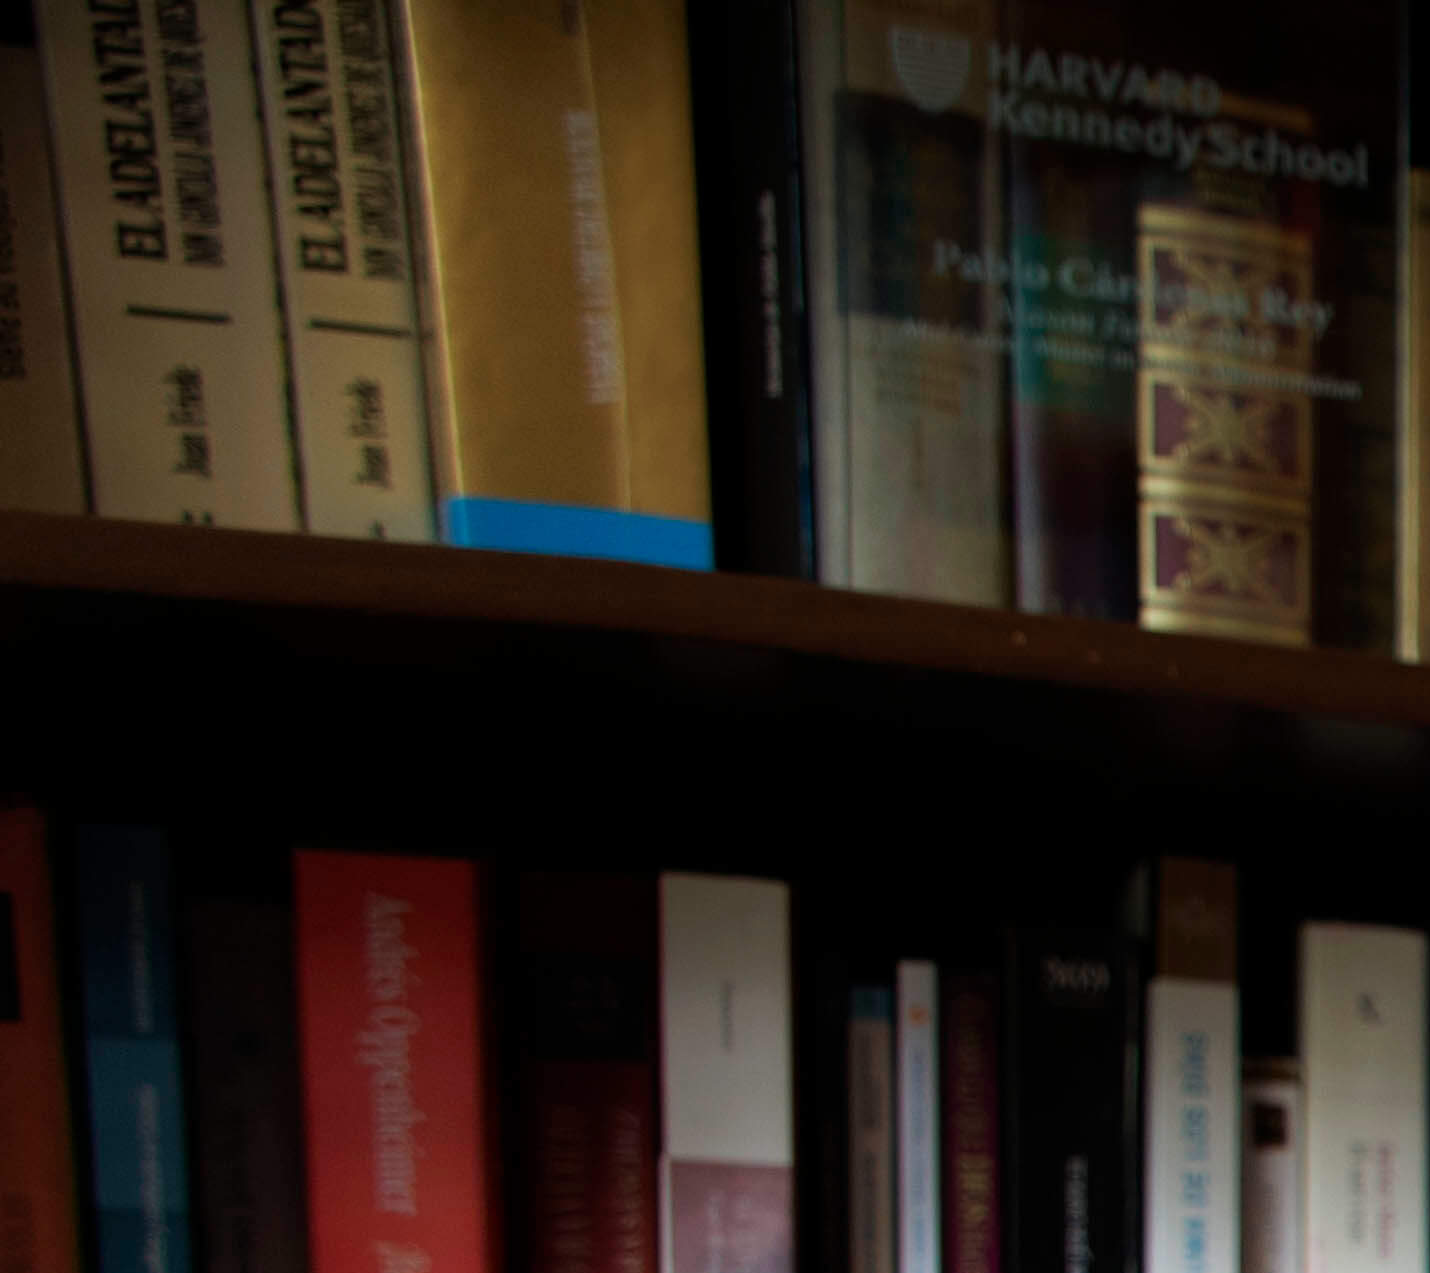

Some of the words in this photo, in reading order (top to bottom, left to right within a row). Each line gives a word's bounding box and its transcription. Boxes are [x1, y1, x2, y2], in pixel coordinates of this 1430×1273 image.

[274, 0, 342, 226] ADELANTAD
[985, 42, 1222, 118] HARVARD
[111, 215, 168, 261] EL
[296, 228, 348, 273] EL
[362, 890, 420, 1000] Andrés
[354, 1003, 427, 1215] Oppenheimer
